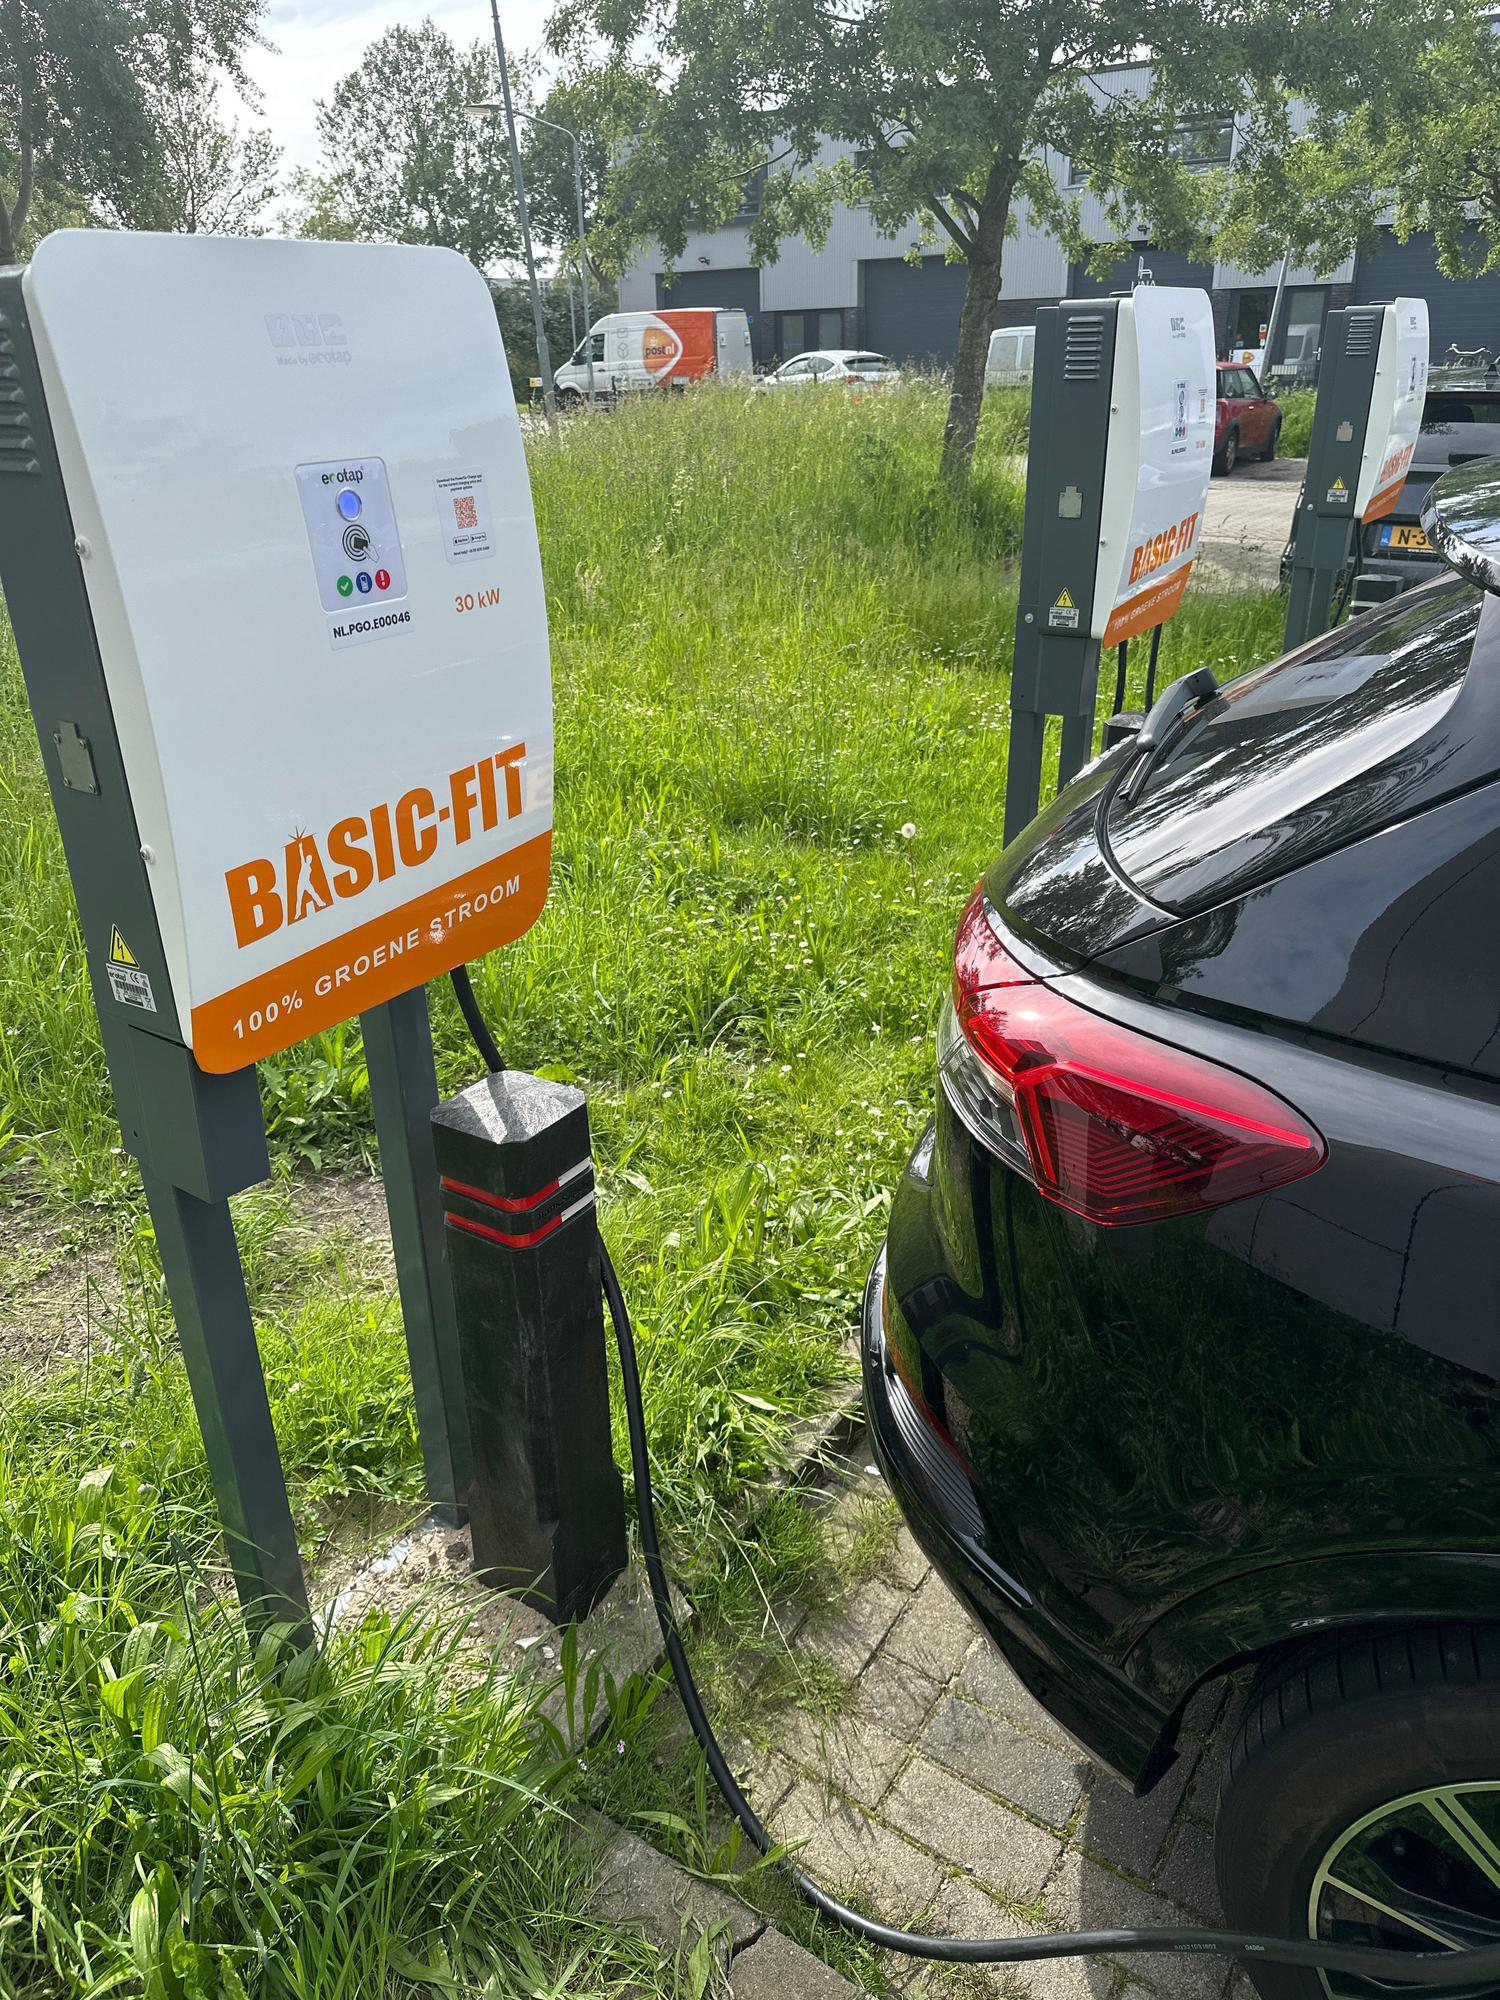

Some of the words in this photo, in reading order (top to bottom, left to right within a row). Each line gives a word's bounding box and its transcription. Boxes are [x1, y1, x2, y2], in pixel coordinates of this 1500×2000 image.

[1128, 511, 1199, 586] BASIC-FIT
[1397, 528, 1430, 546] N-3
[333, 611, 411, 639] NL.PGO.E00046
[456, 593, 474, 613] 30
[477, 588, 501, 609] kW
[225, 742, 526, 949] BASIC-FIT
[232, 993, 304, 1040] 100%
[315, 928, 420, 997] GROENE
[429, 874, 522, 934] STROOM
